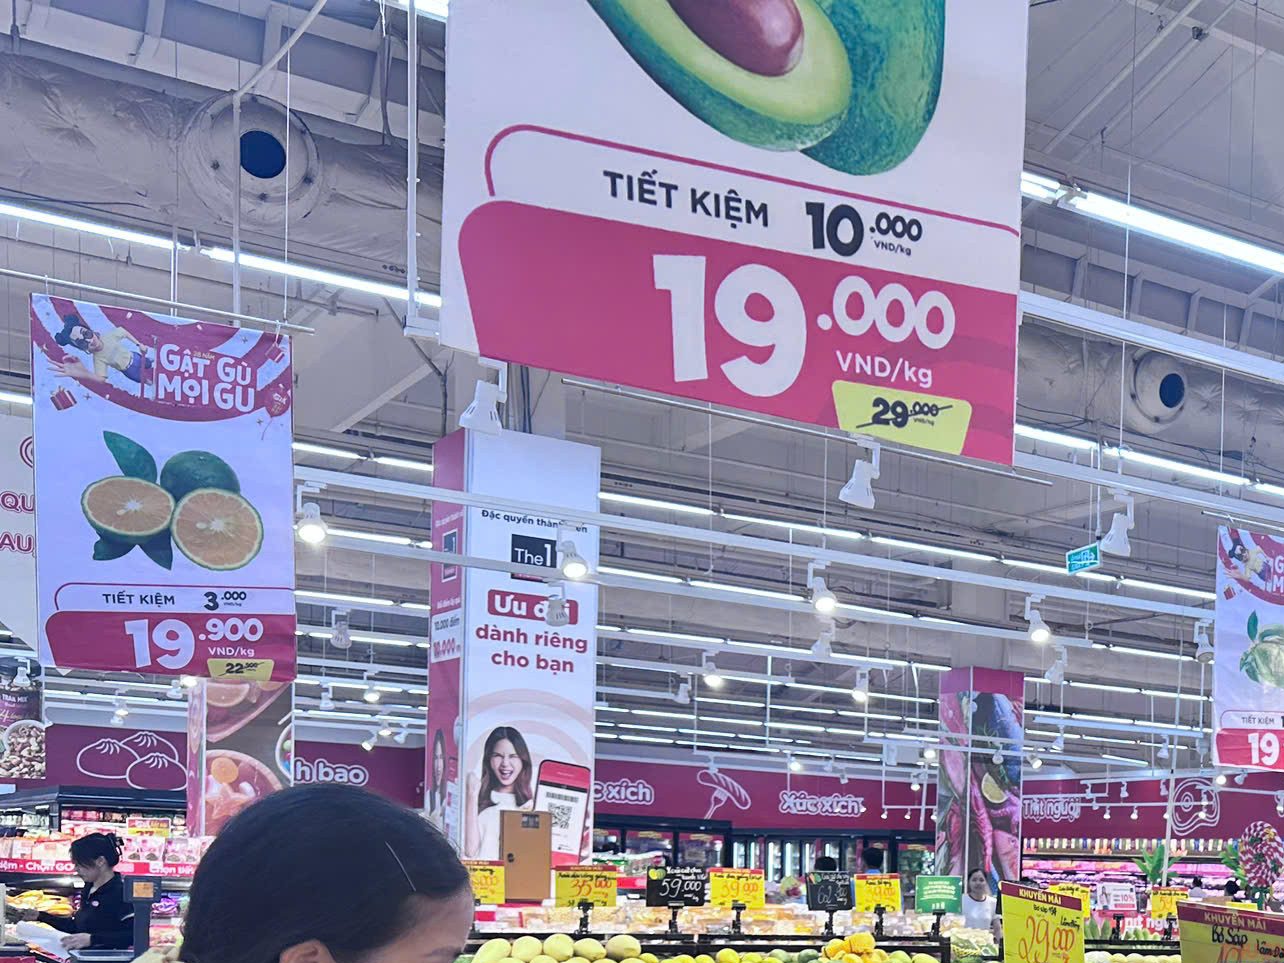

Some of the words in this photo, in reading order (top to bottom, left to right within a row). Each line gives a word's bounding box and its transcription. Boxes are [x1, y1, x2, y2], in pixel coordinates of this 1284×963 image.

[602, 170, 679, 208] TIẾT
[690, 188, 769, 229] KIỆM
[873, 240, 912, 257] VND/kg
[159, 343, 211, 378] GẬT
[217, 357, 252, 386] GÙ
[836, 350, 933, 389] VND/kg
[158, 373, 209, 405] MỌI
[213, 383, 255, 412] GU
[481, 509, 501, 521] Đặc
[503, 513, 534, 526] quyền
[536, 518, 561, 529] thàn
[102, 590, 135, 605] TIẾT
[140, 593, 175, 608] KIỆM
[493, 594, 527, 616] Ưu
[534, 598, 570, 622] đi
[475, 624, 528, 645] dành
[535, 632, 588, 653] riêng
[207, 646, 255, 657] VND/kg
[491, 651, 530, 668] cho
[536, 654, 574, 675] bạn
[1241, 714, 1256, 725] TIẾT
[317, 760, 367, 785] bao
[606, 780, 652, 802] xích
[781, 792, 818, 813] Xúc
[1018, 888, 1047, 902] KHUYẾN
[1204, 910, 1246, 928] KHUYẾN
